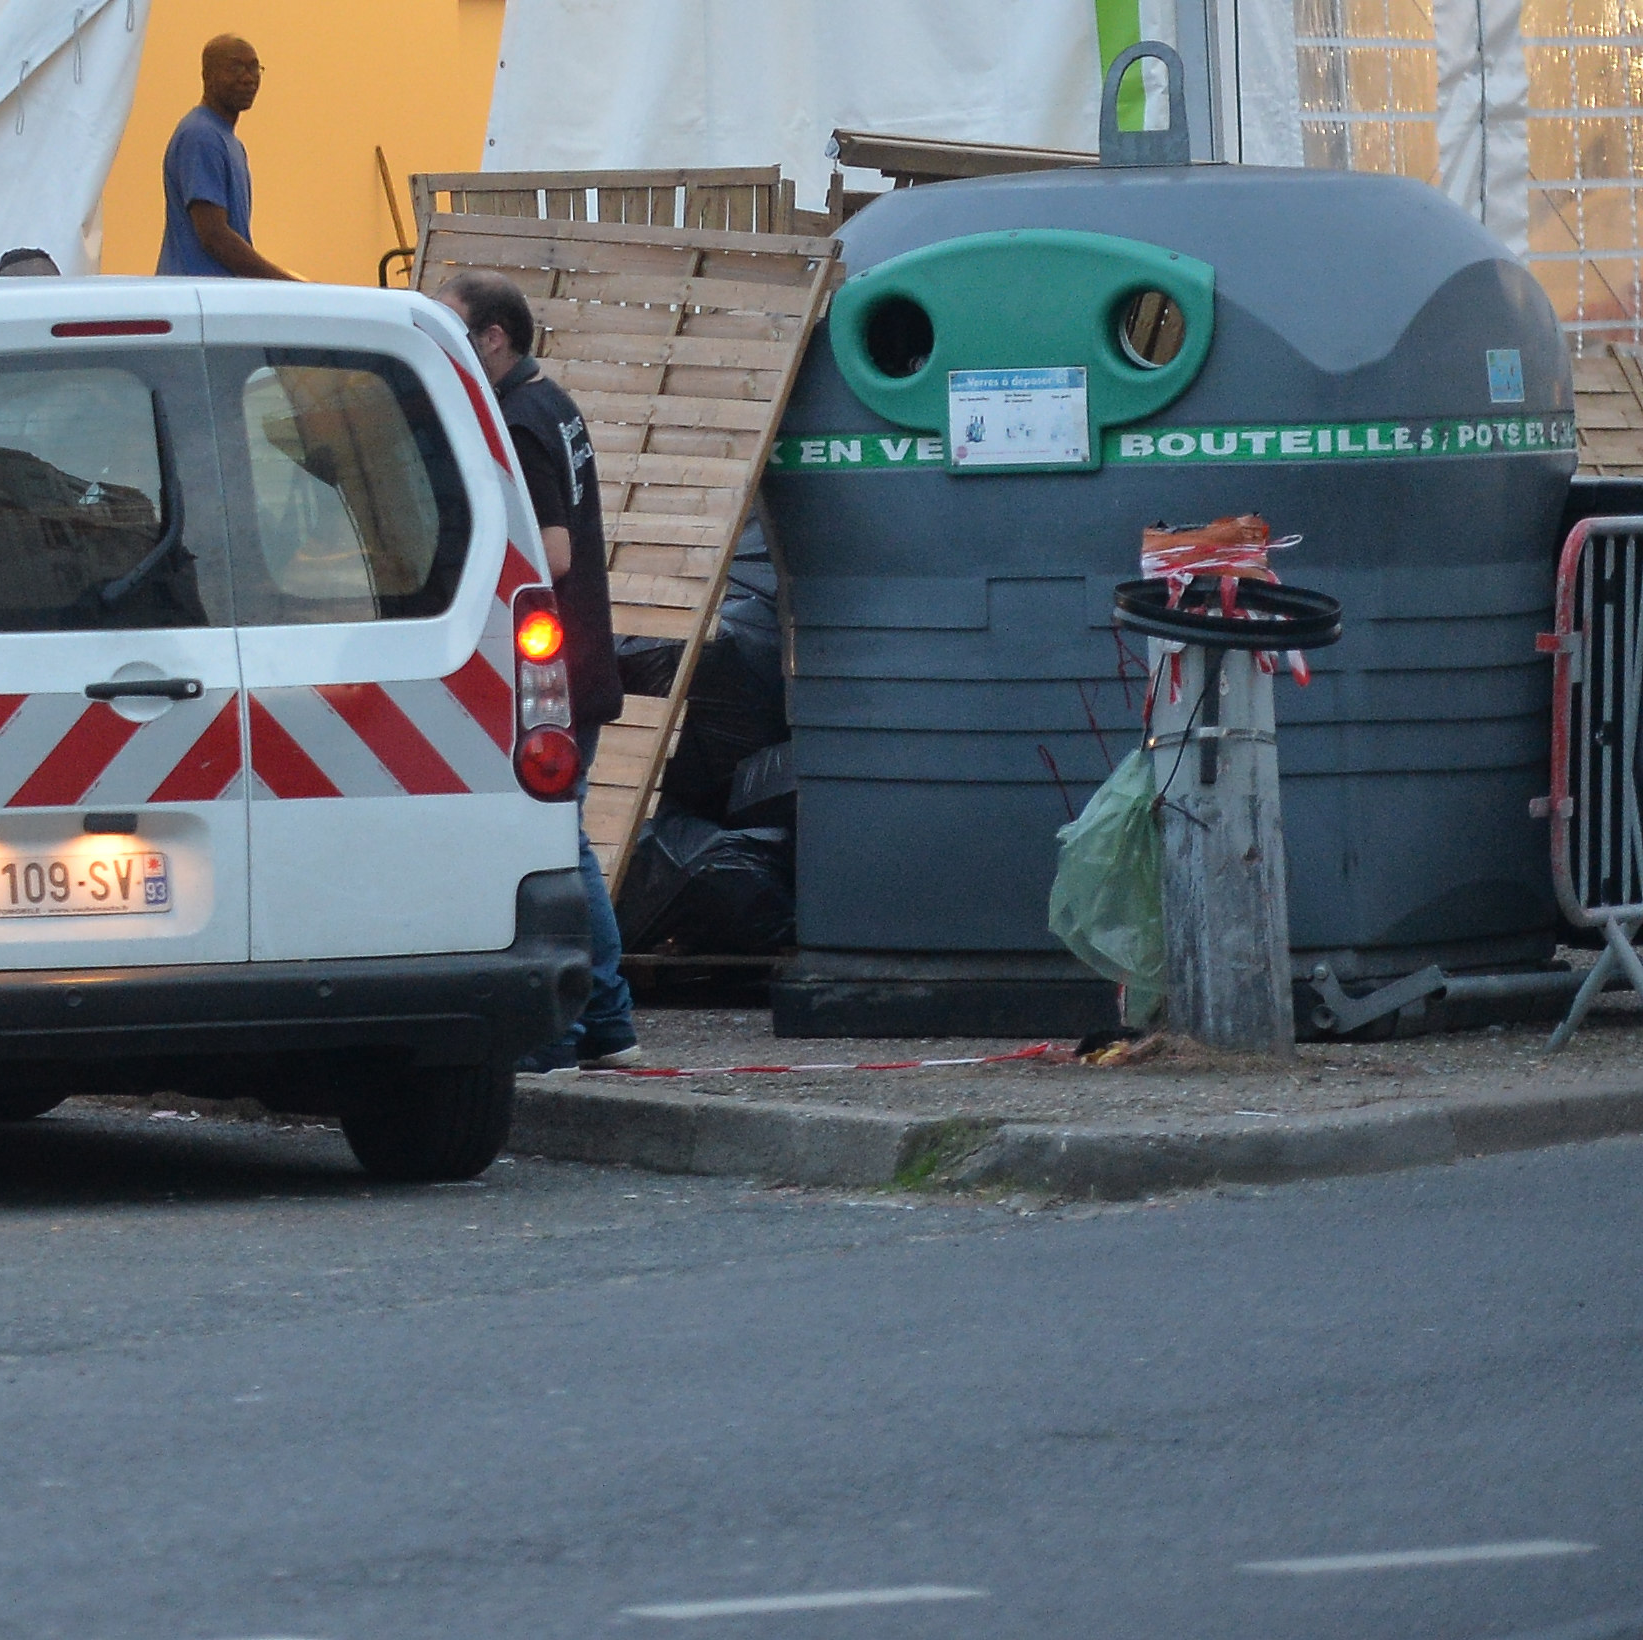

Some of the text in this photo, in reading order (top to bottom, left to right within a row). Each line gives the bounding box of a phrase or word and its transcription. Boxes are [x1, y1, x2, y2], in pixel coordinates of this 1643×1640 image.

[800, 439, 862, 464] EN
[1120, 426, 1435, 458] BOUTEILLES
[144, 881, 168, 903] 93
